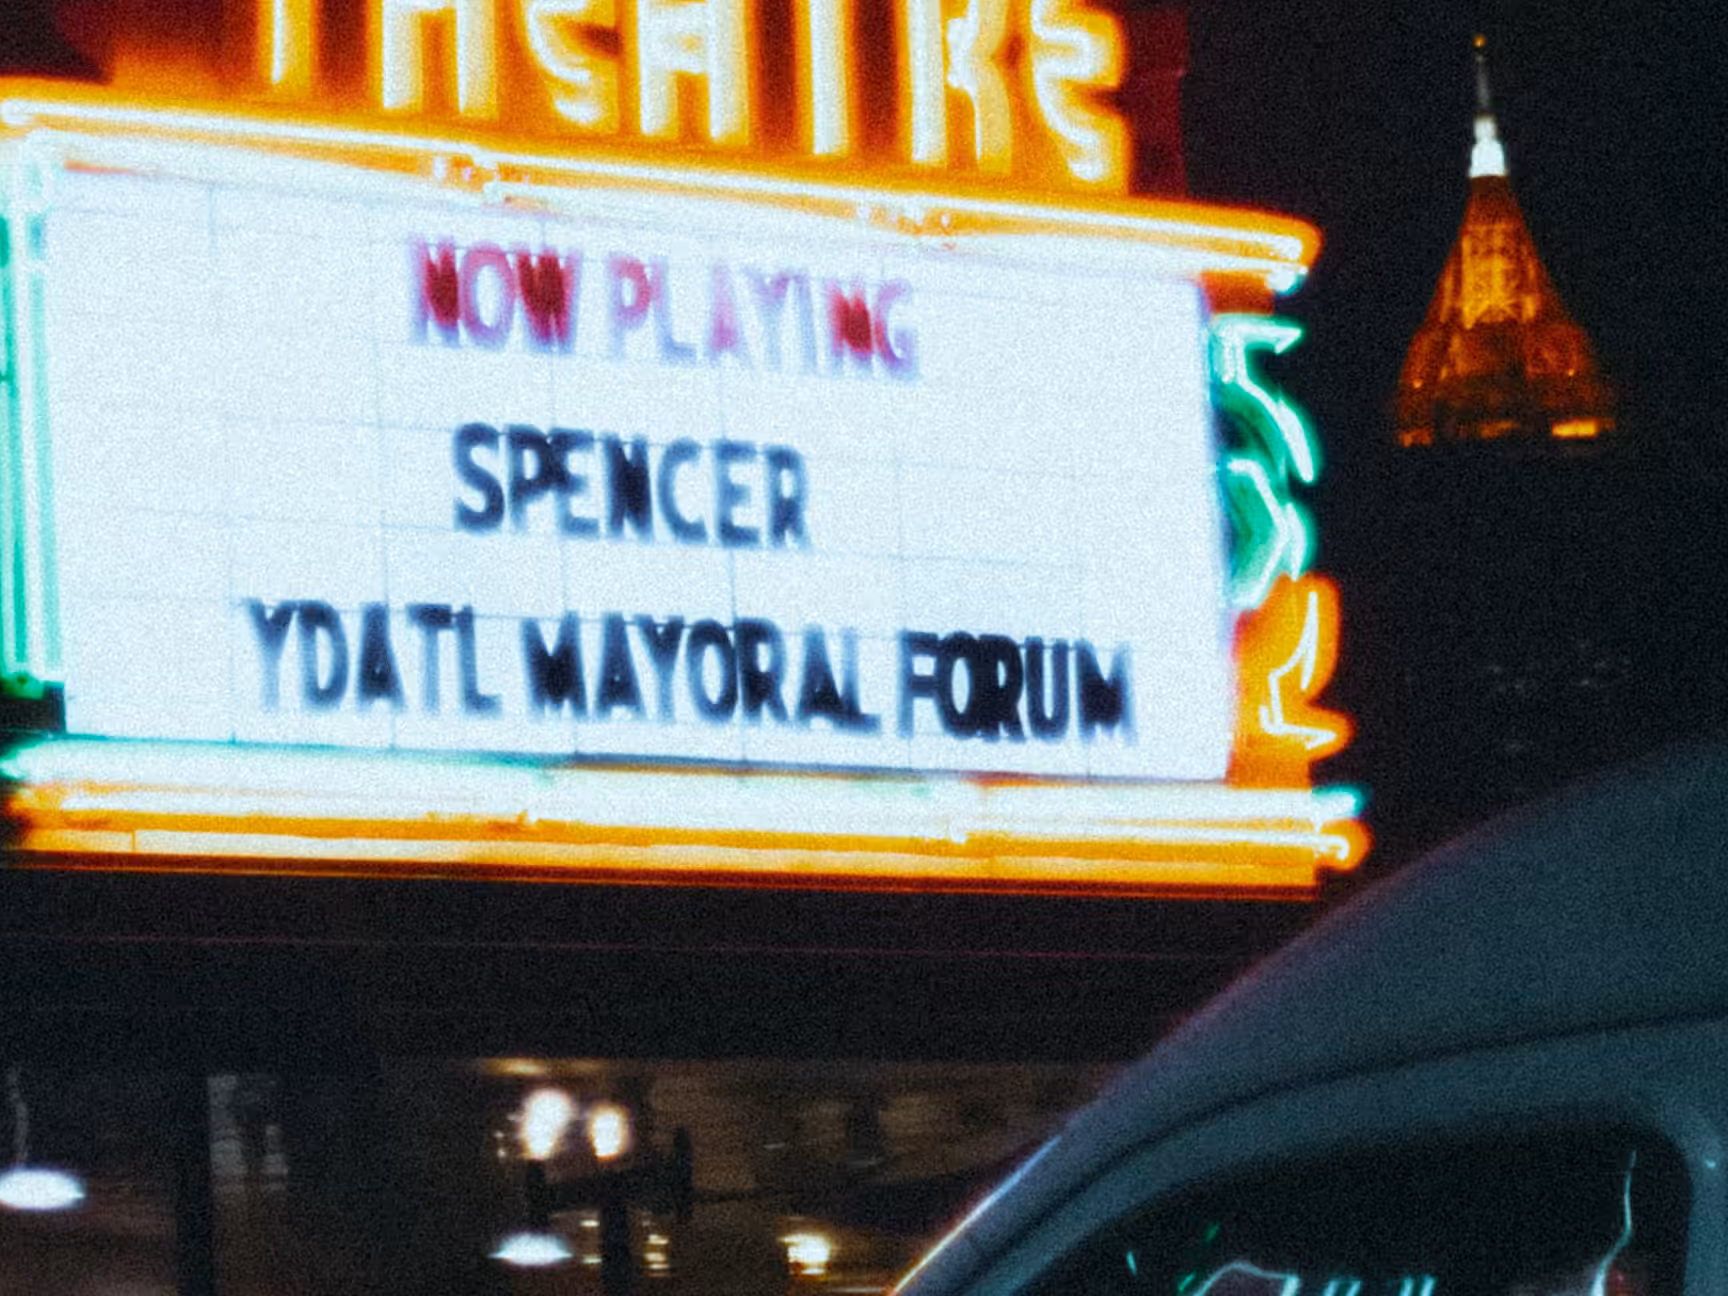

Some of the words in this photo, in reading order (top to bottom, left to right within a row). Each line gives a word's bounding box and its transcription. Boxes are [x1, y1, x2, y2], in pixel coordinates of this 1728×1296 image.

[409, 233, 583, 350] NOW
[607, 250, 921, 382] PLAYING
[451, 421, 813, 551] SPENCER
[242, 595, 503, 718] YDATL
[519, 609, 883, 737] MAYORAL
[896, 627, 1140, 746] FORUM
